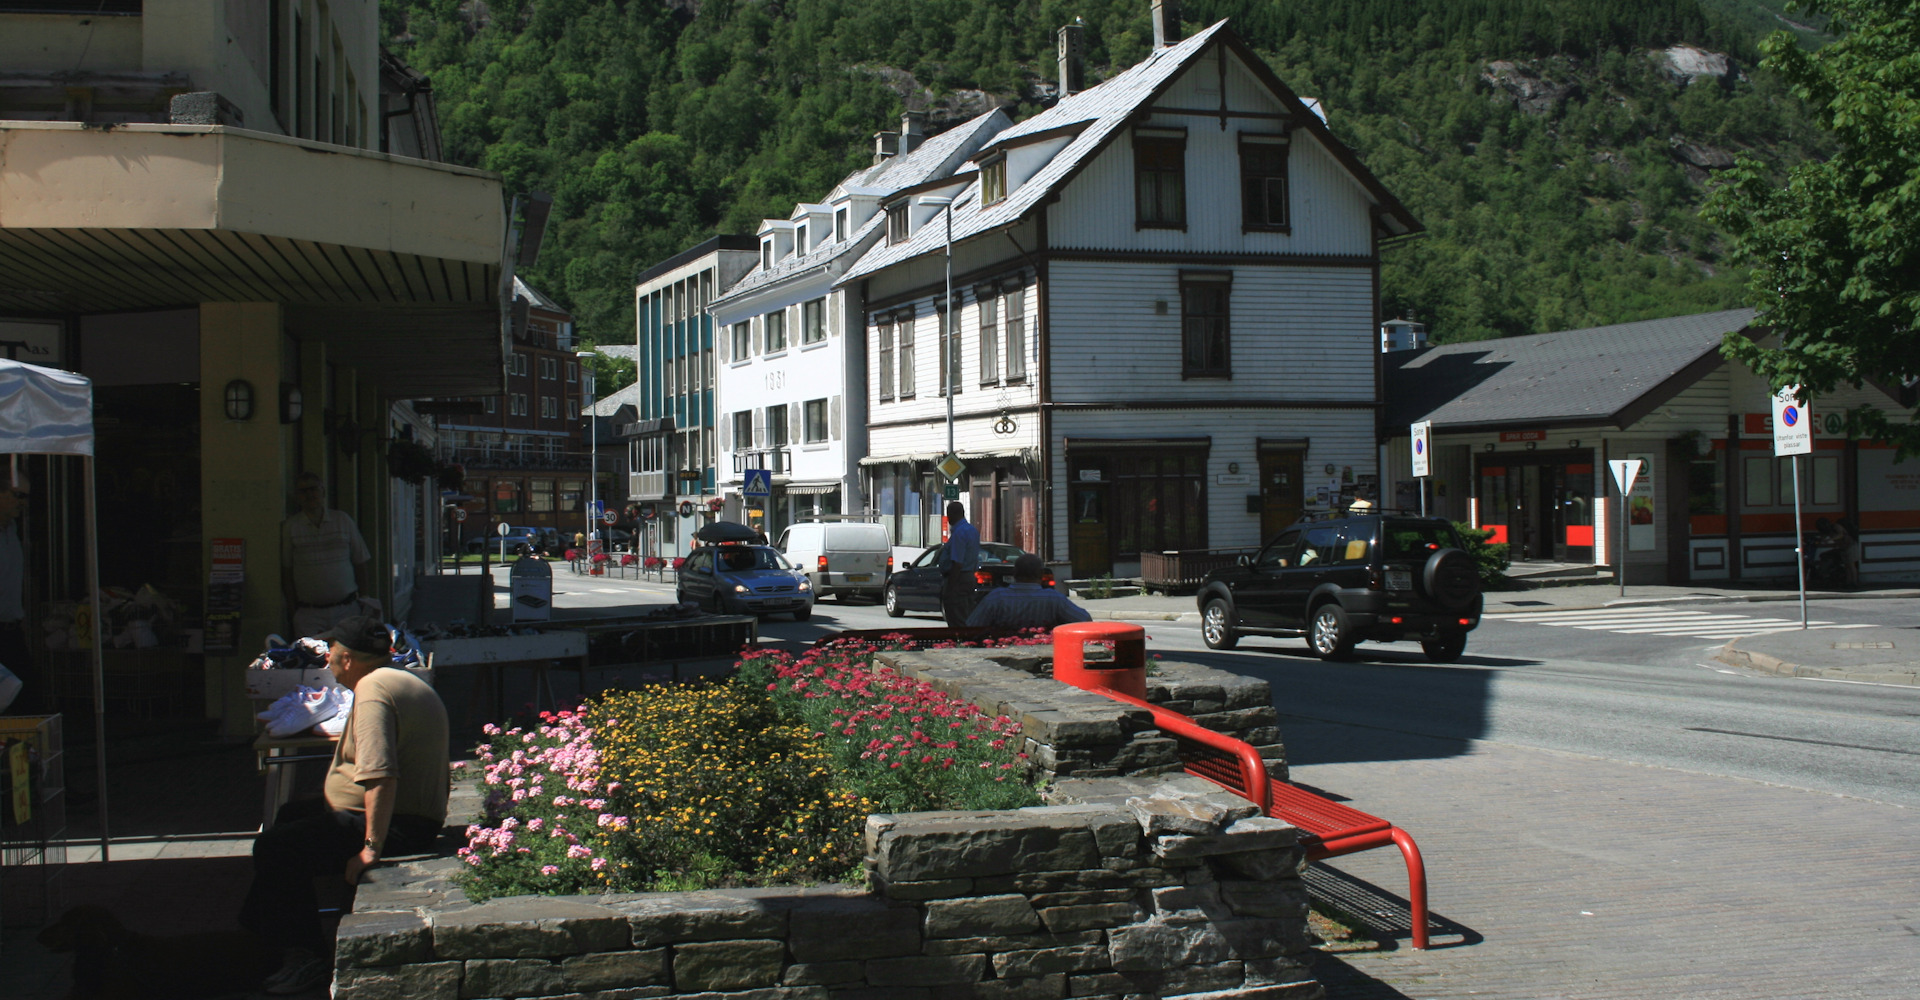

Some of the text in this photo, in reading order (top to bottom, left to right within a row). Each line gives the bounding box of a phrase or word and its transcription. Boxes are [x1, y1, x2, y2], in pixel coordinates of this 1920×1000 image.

[765, 370, 786, 390] 1931
[946, 488, 956, 496] 13
[682, 505, 690, 514] N
[605, 513, 616, 522] 30
